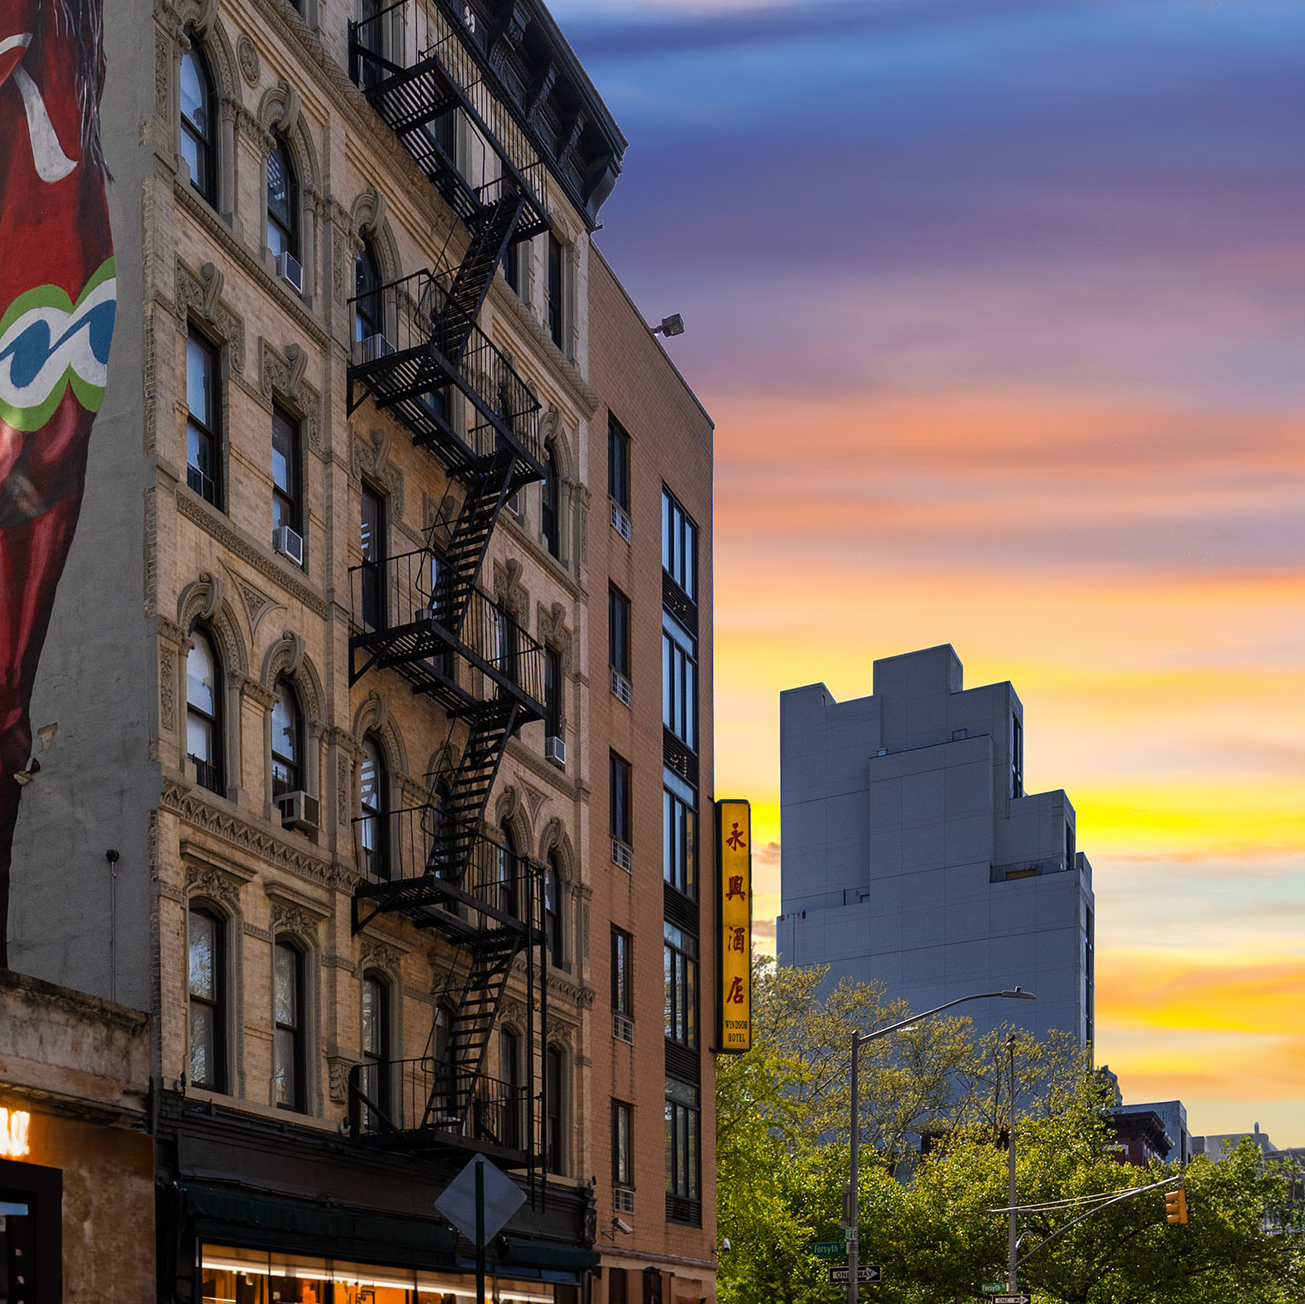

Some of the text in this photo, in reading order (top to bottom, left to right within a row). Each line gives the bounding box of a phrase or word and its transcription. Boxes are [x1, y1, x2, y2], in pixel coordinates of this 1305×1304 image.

[725, 822, 748, 1005] 永興酒店
[725, 1020, 748, 1030] WINDSOR
[728, 1033, 746, 1043] HOTEL
[814, 1244, 838, 1254] Forsyth
